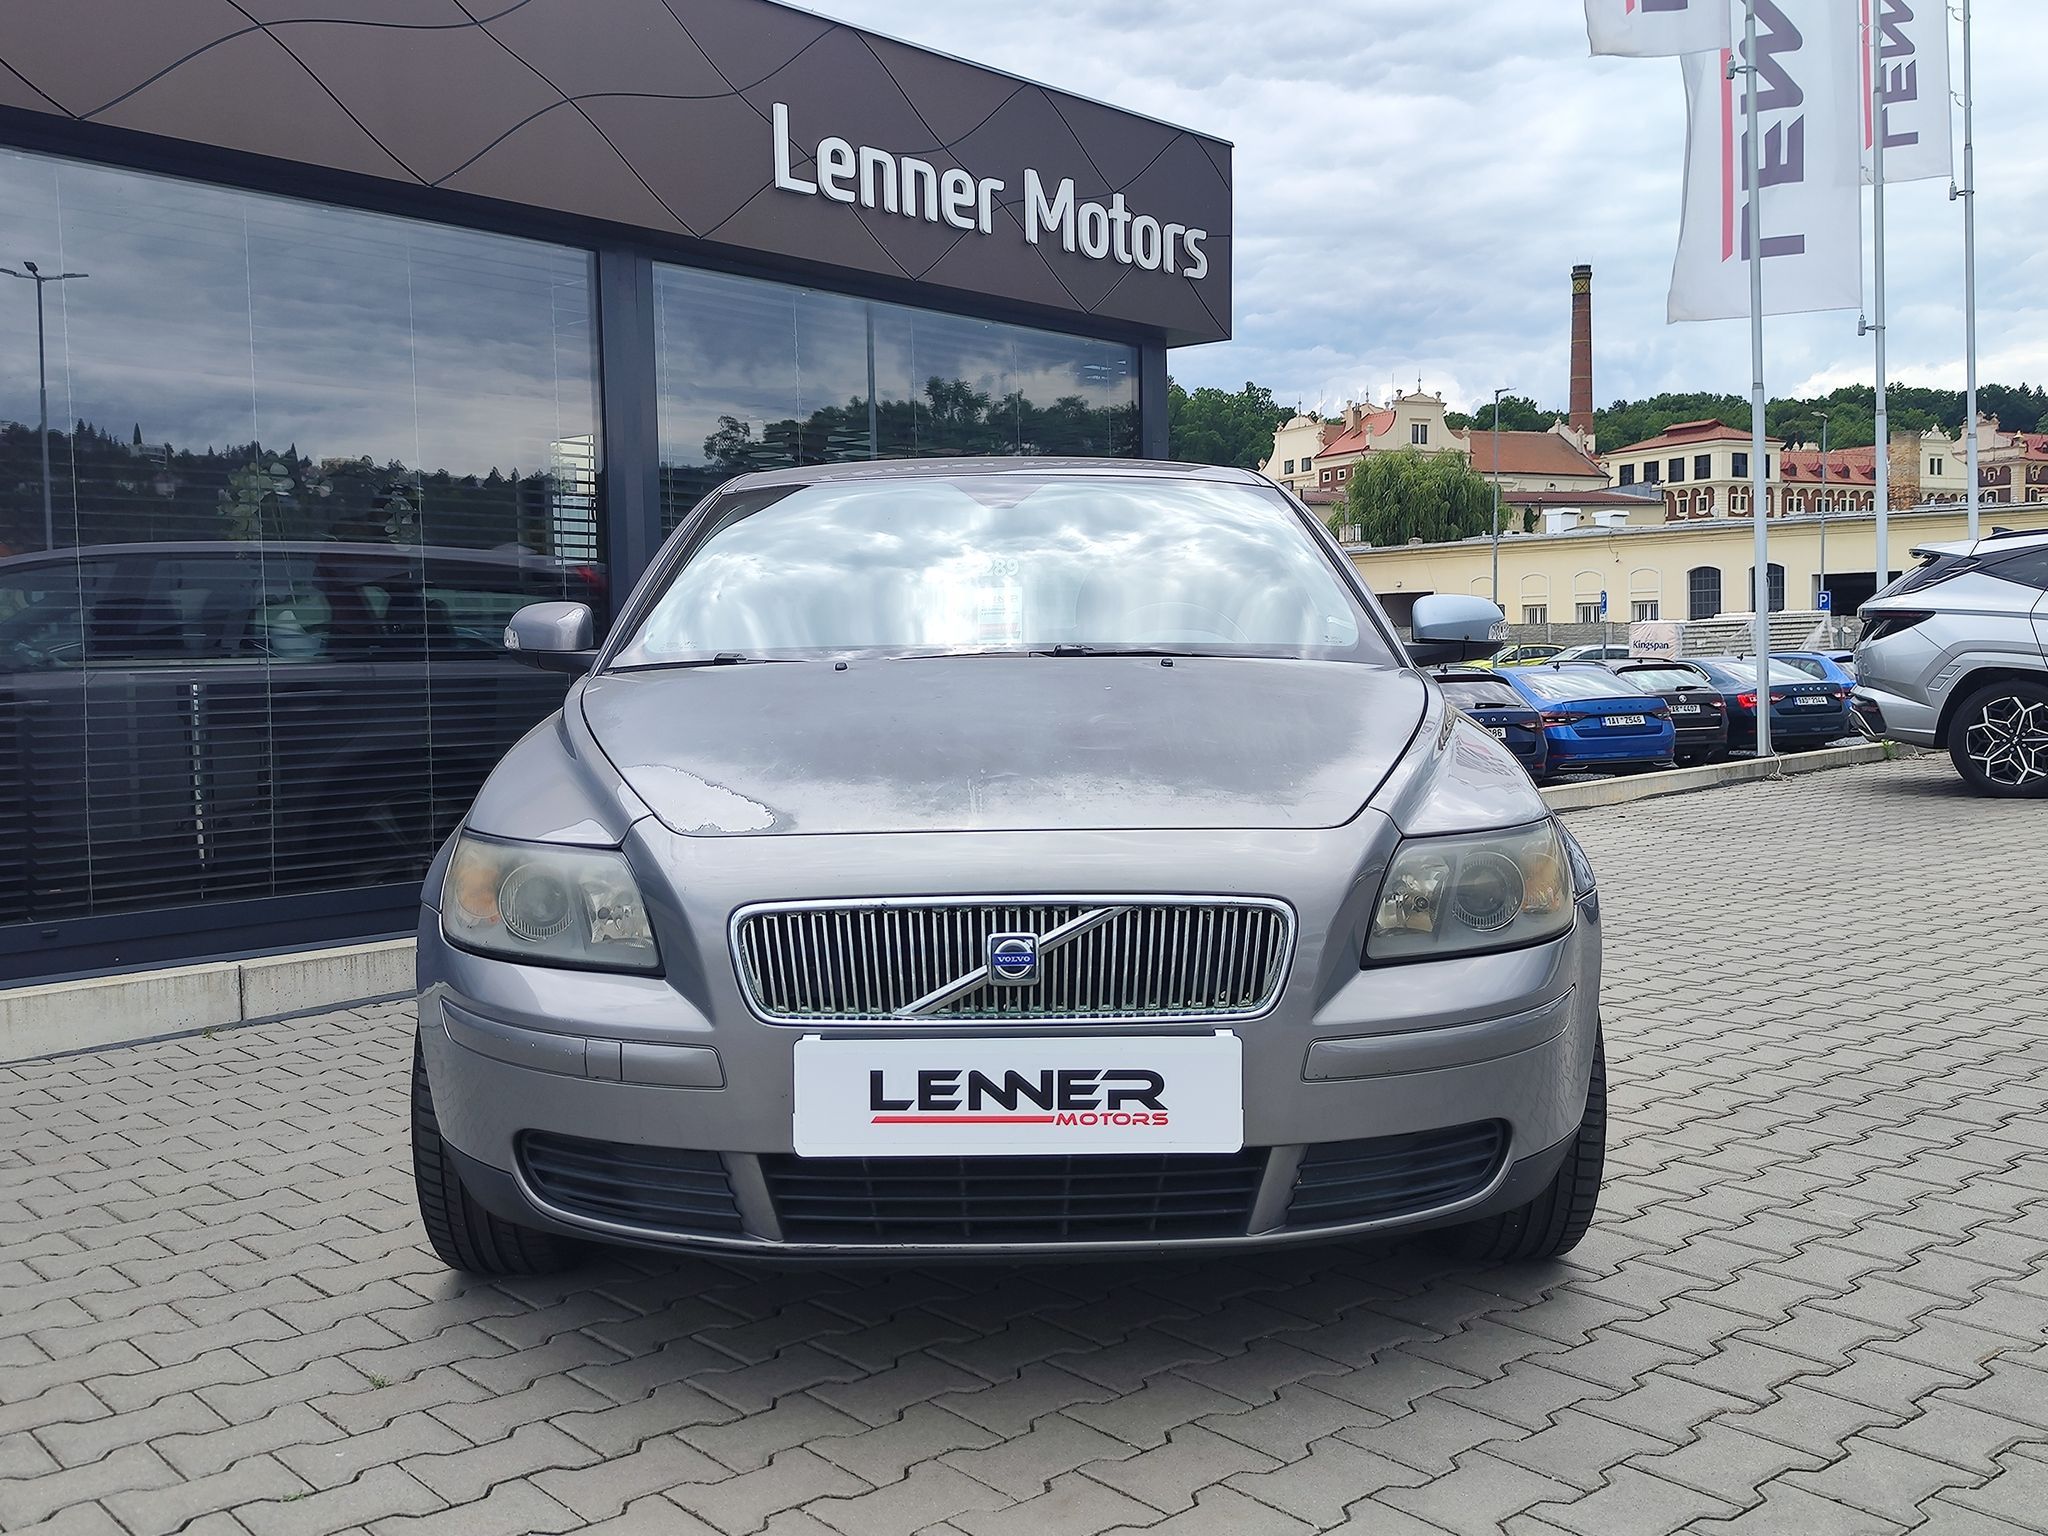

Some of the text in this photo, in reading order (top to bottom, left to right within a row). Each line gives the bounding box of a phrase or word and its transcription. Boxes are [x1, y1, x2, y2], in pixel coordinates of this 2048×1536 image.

[772, 102, 1208, 280] Lenner Motors
[1819, 594, 1828, 608] P
[1632, 640, 1669, 651] Kingspan
[997, 955, 1031, 964] VOLVO
[869, 1069, 1169, 1111] LENNER
[1055, 1112, 1169, 1126] MOTORS
